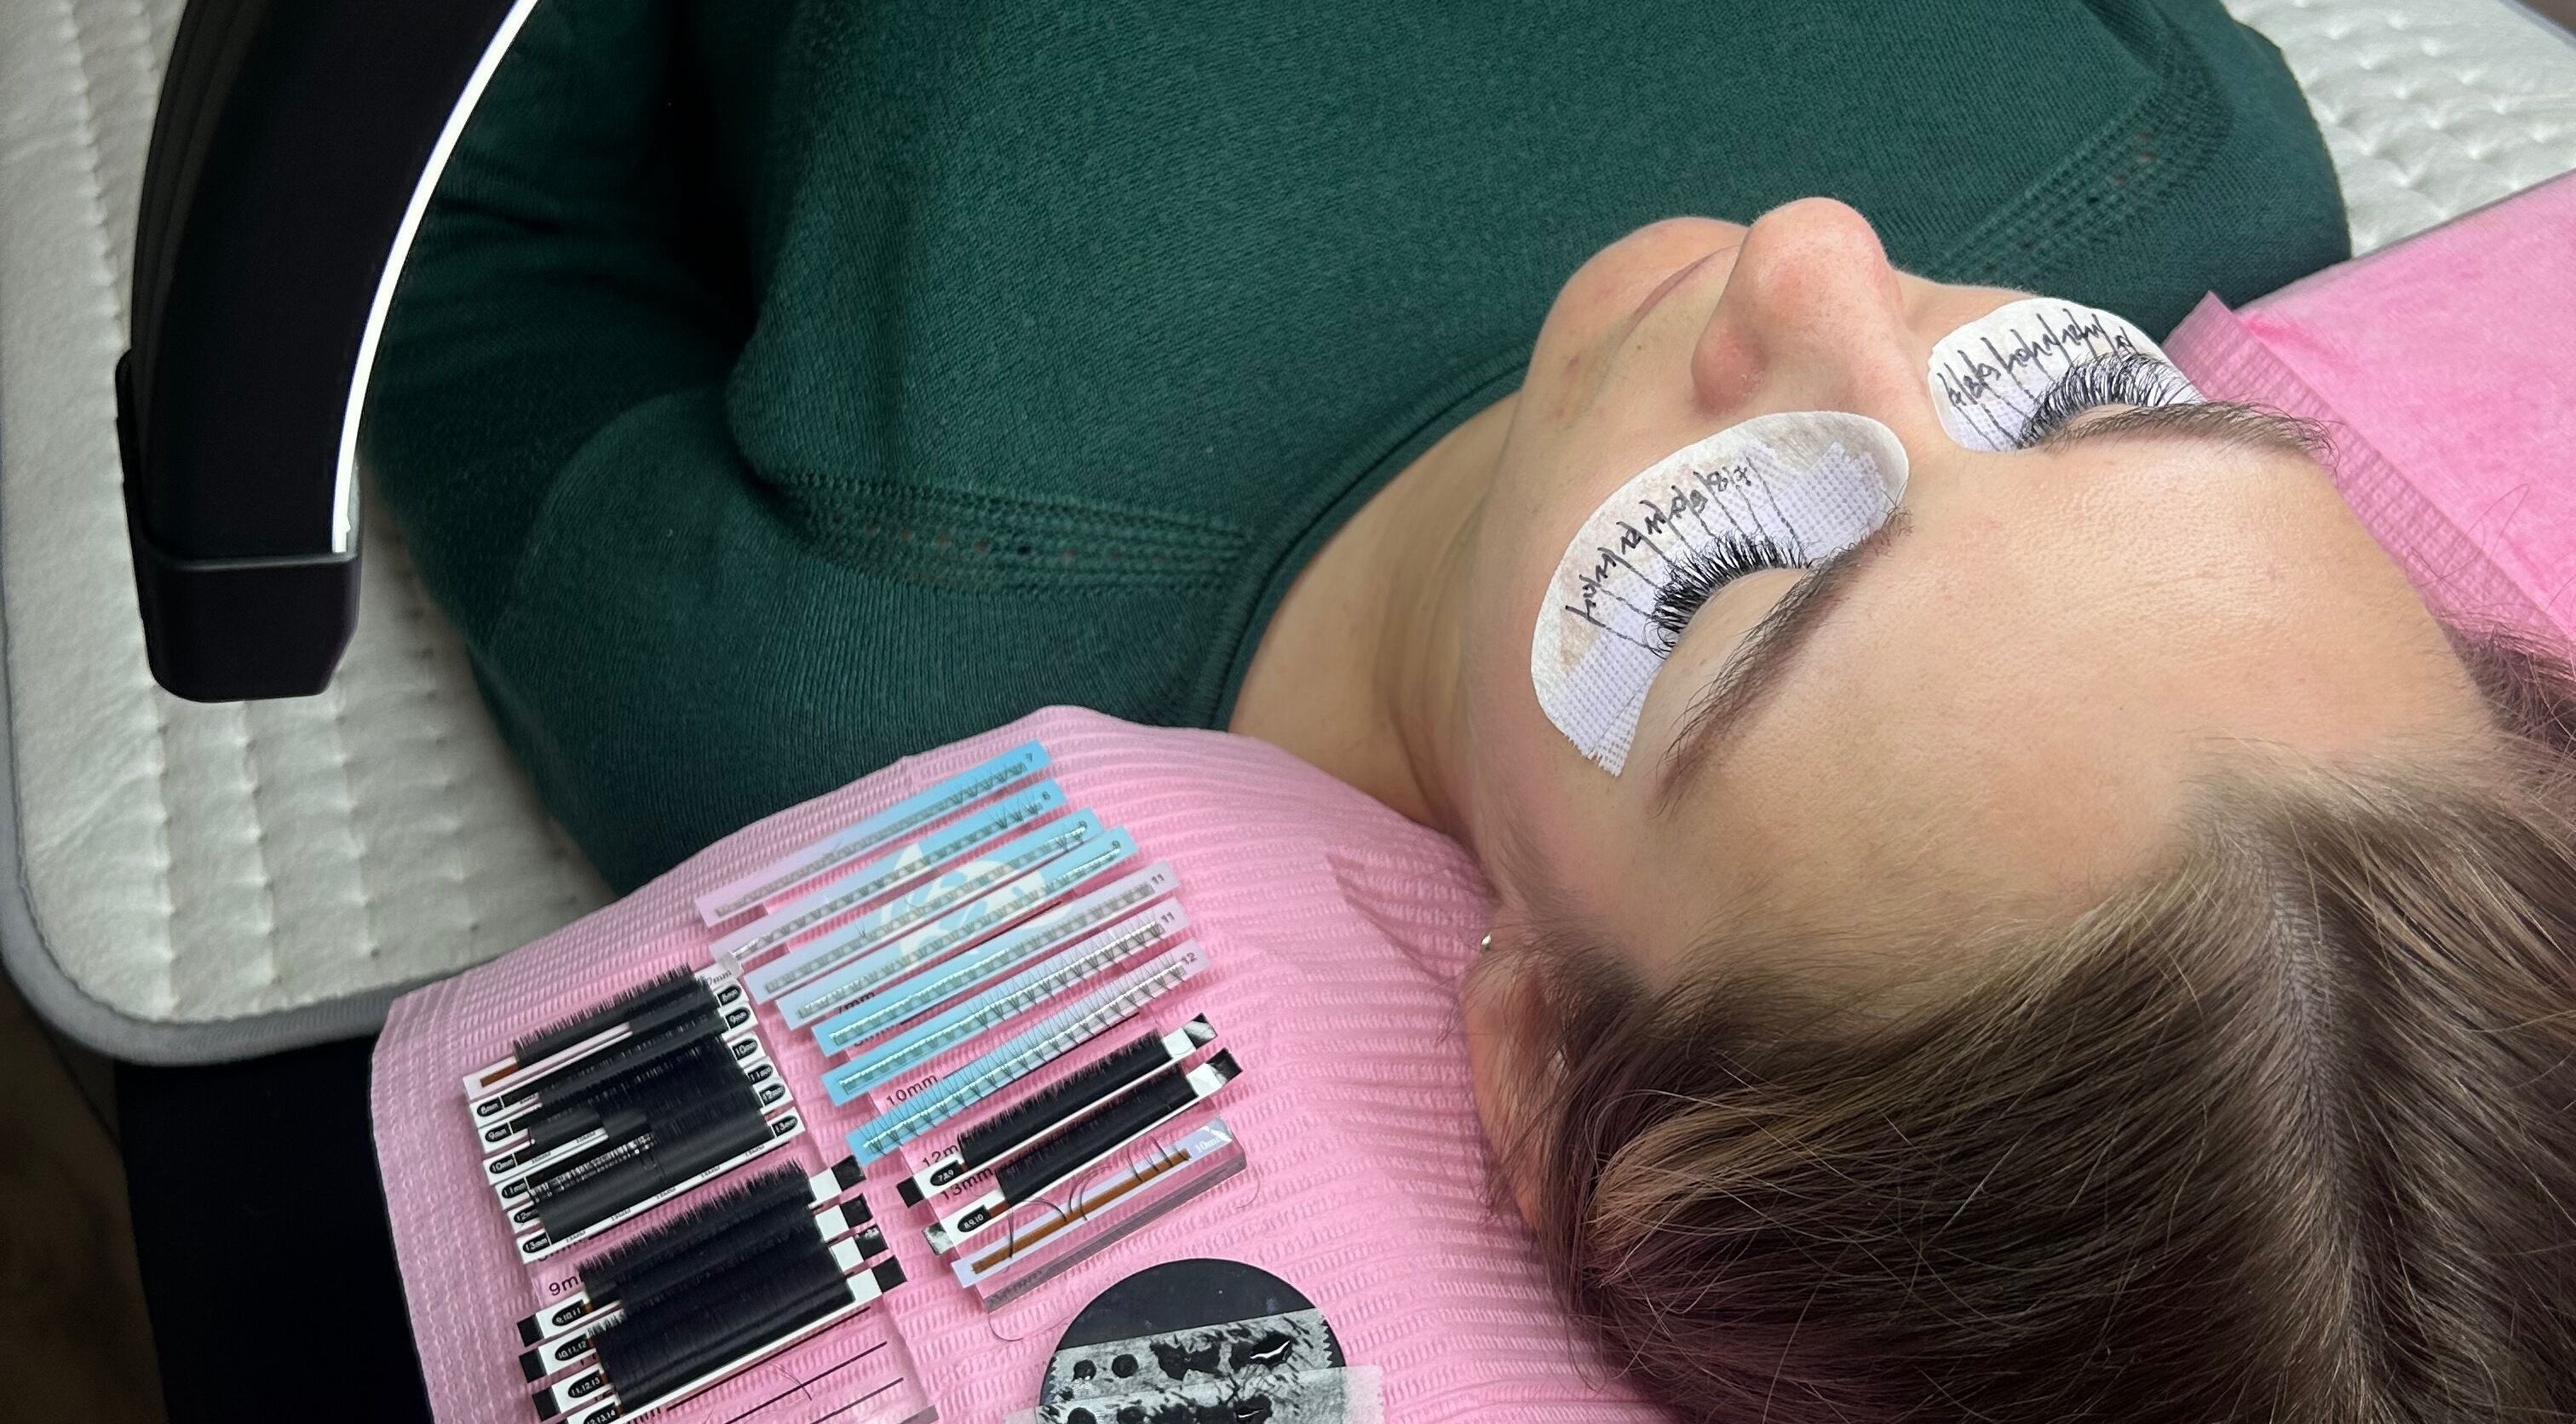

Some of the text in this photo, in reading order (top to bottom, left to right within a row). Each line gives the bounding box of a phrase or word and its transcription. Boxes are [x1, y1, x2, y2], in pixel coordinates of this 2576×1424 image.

[1152, 873, 1165, 885] 11
[1161, 911, 1176, 924] 11
[1181, 952, 1198, 965] 12
[887, 1075, 939, 1105] 10mm
[922, 1145, 959, 1167] 12m
[940, 1168, 994, 1200] 13mm
[549, 1274, 584, 1297] 9m
